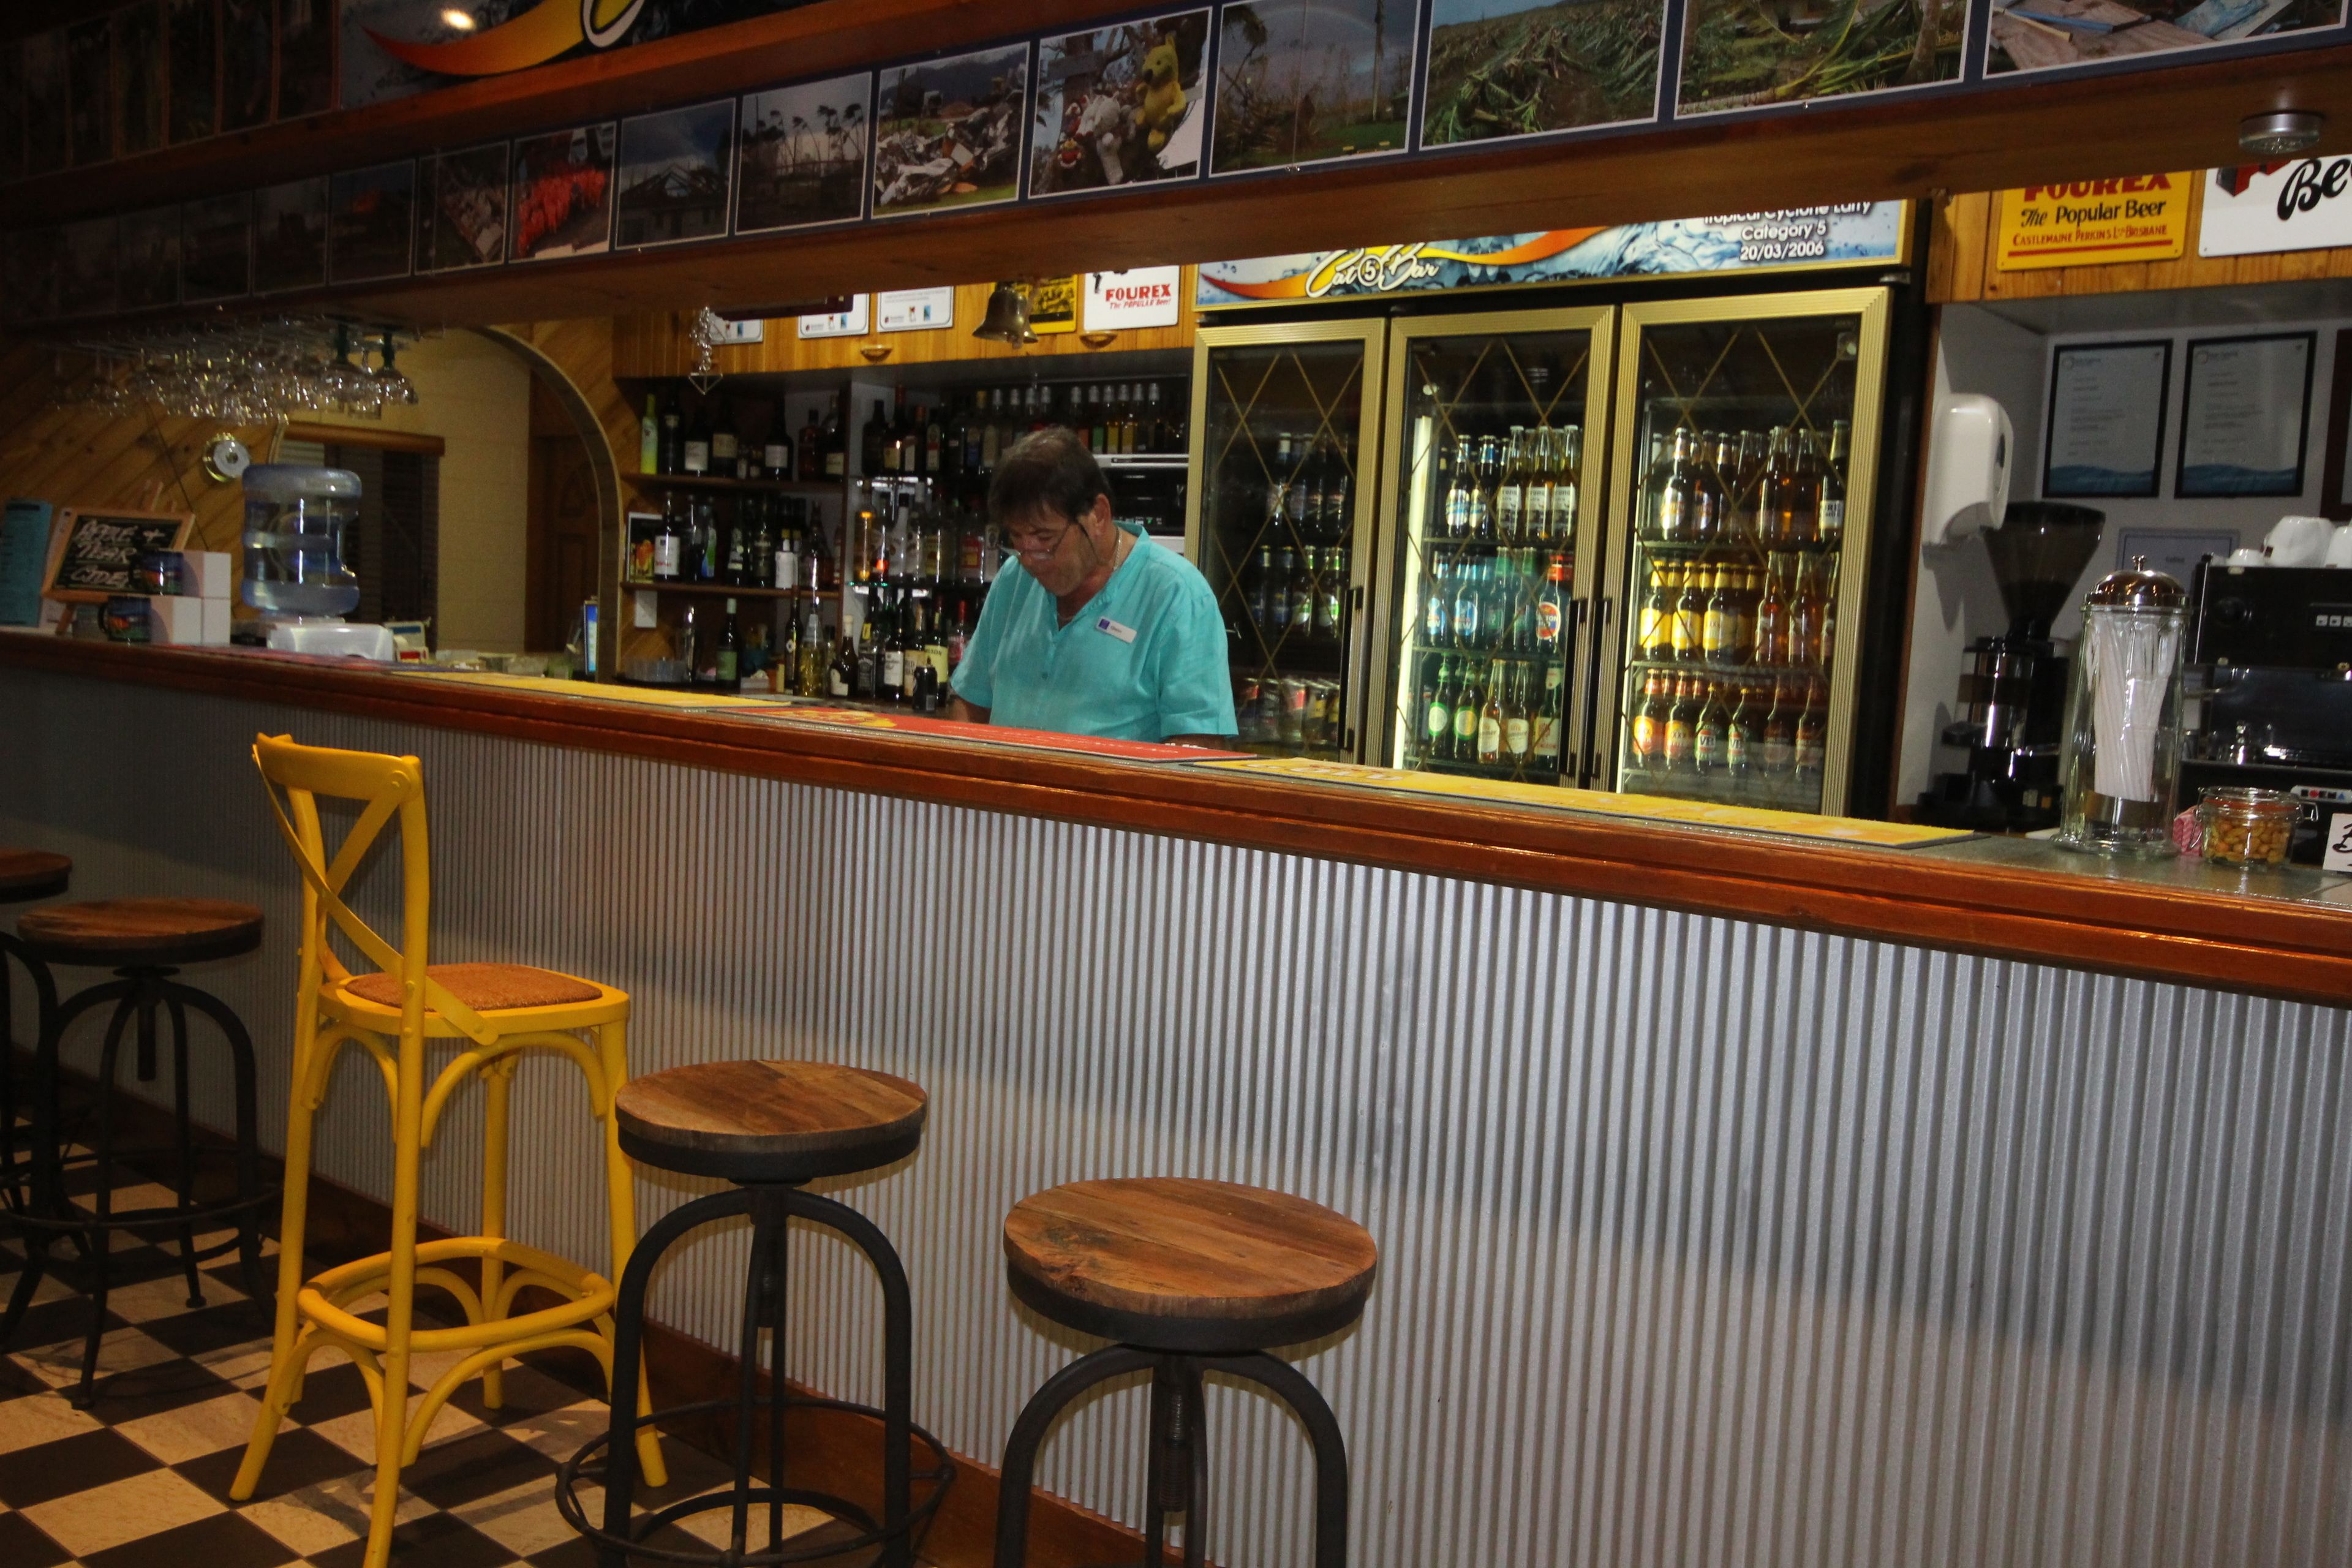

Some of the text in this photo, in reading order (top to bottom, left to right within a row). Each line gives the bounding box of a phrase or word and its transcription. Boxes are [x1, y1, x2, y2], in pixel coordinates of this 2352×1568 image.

[2277, 158, 2352, 221] Be
[2021, 199, 2167, 227] The Popular Beer
[1741, 219, 1827, 242] Category 5
[1740, 241, 1825, 262] 20/03/2006
[1306, 248, 1366, 298] Cat
[1378, 243, 1439, 292] Bar
[1106, 284, 1171, 301] FOUREX
